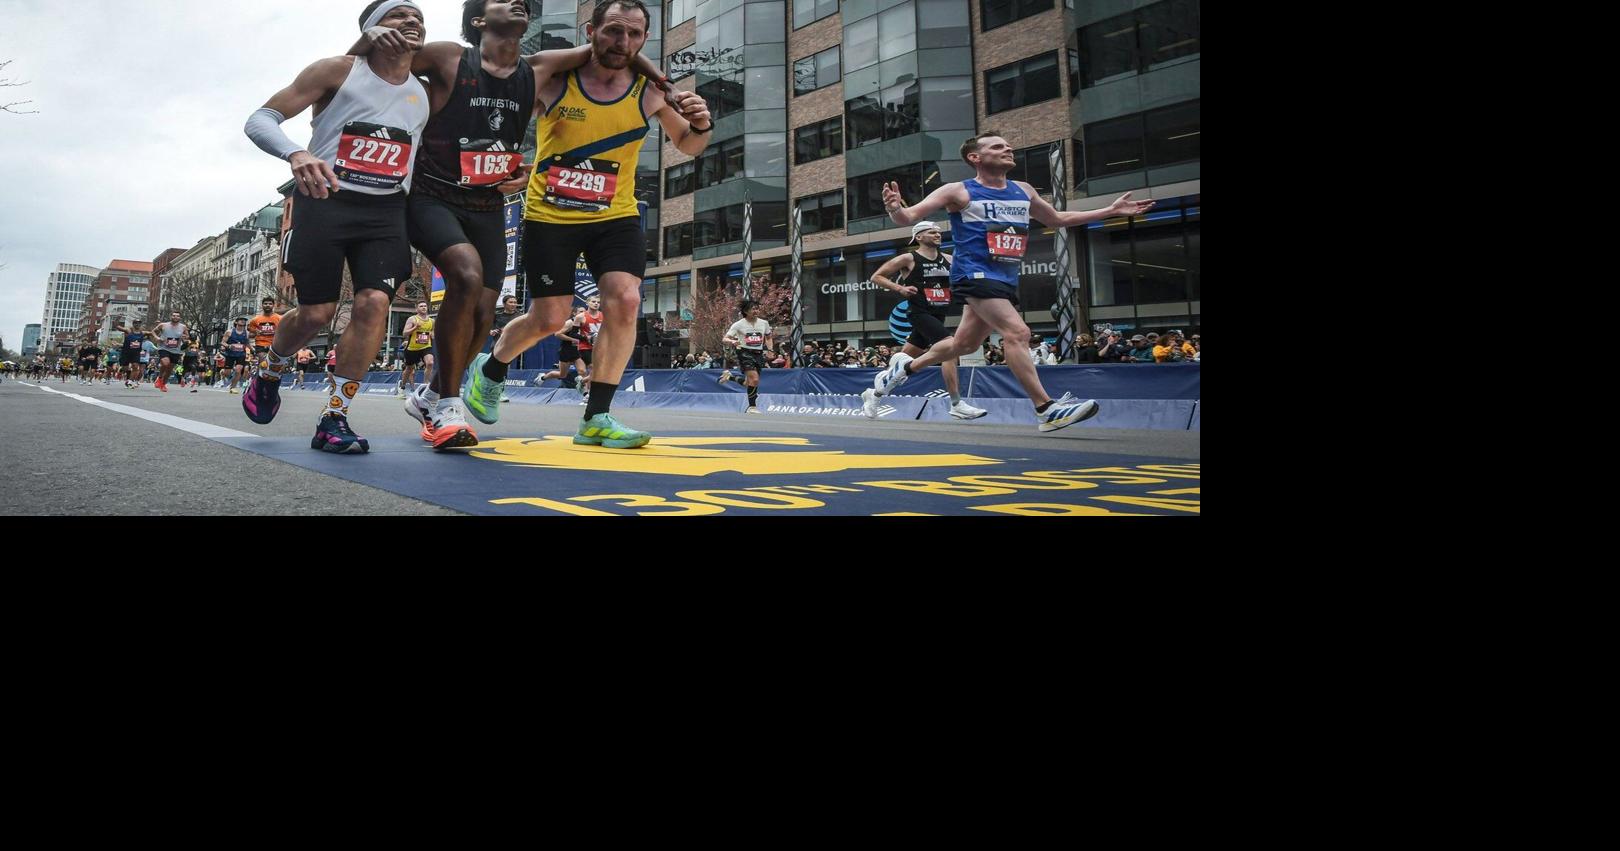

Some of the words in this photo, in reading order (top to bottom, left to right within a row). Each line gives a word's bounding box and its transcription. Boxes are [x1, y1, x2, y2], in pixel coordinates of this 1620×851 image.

[350, 138, 402, 167] 2272
[557, 170, 606, 192] 2289
[995, 234, 1023, 251] 1375
[767, 405, 798, 413] BANK
[798, 406, 814, 414] OF
[814, 407, 865, 416] AMERICA
